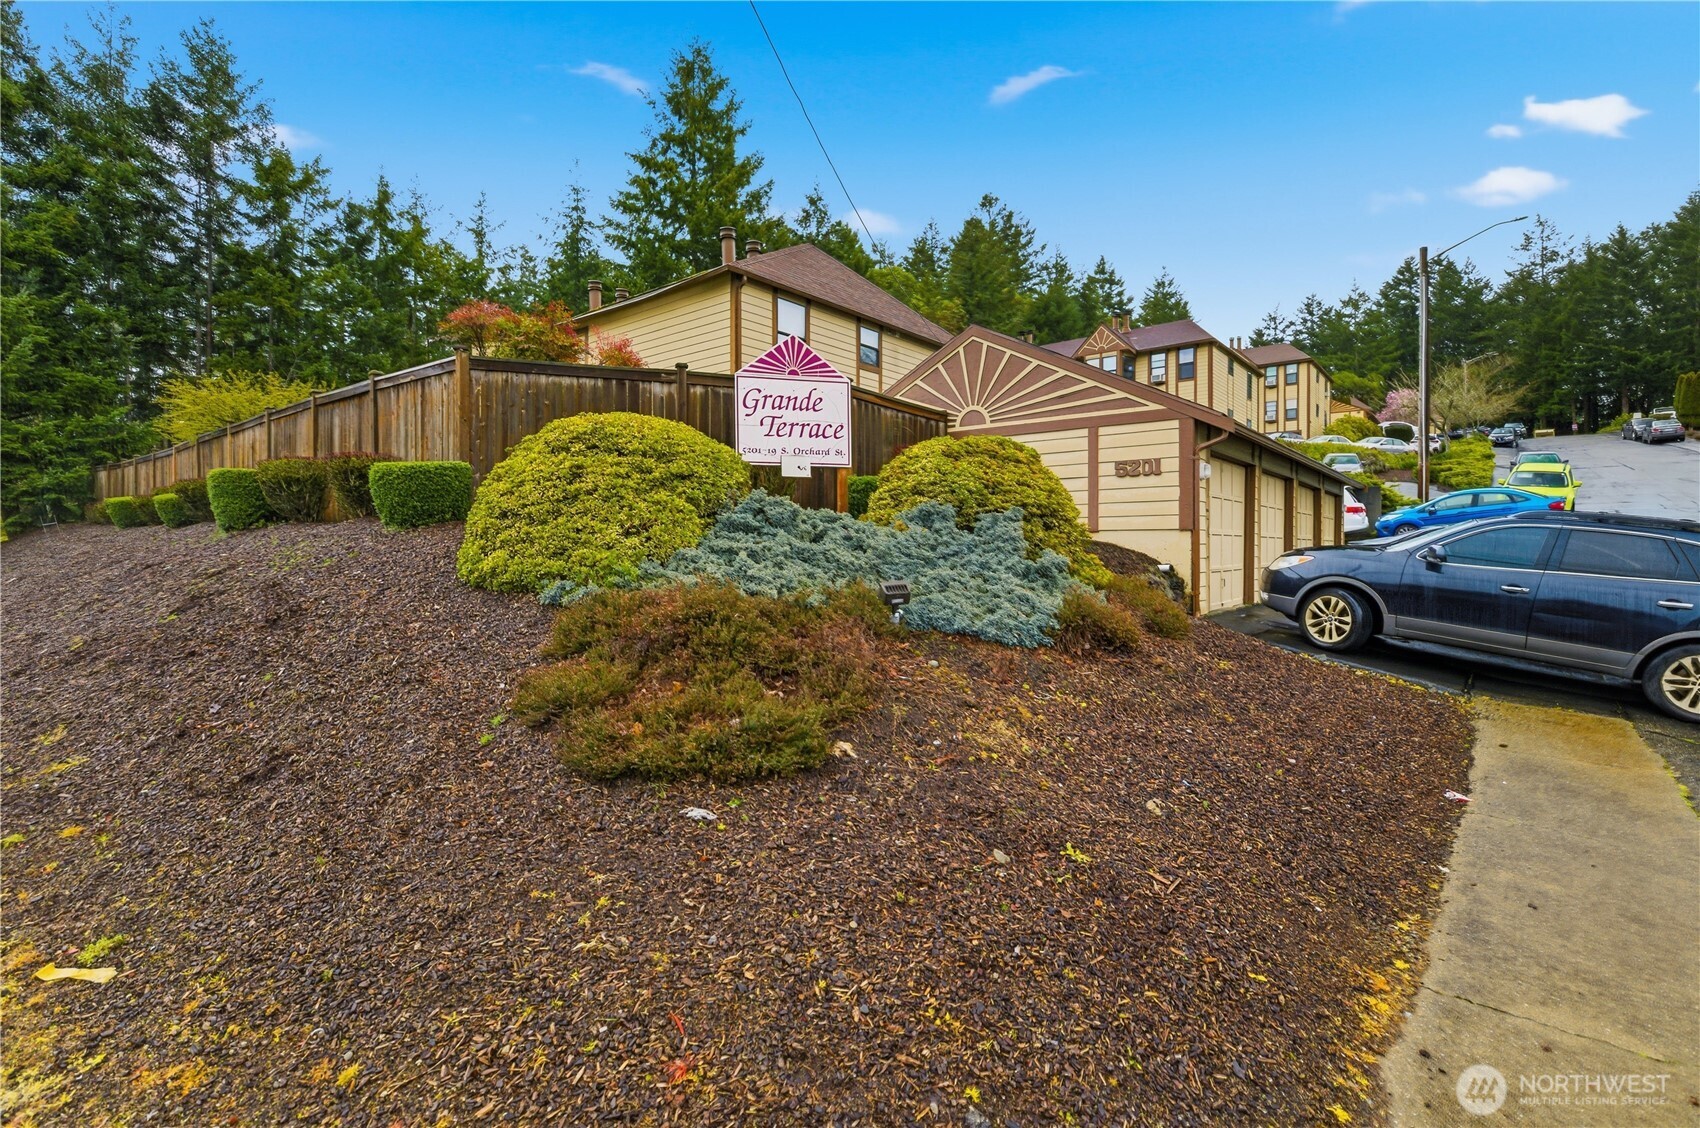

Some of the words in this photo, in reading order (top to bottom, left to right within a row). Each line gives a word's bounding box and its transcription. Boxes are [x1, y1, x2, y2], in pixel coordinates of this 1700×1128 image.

[742, 387, 824, 417] Grande
[759, 414, 845, 440] Terrace
[780, 447, 789, 455] S.
[793, 446, 830, 456] Orchard
[834, 448, 846, 456] St.
[1114, 458, 1162, 477] 5201
